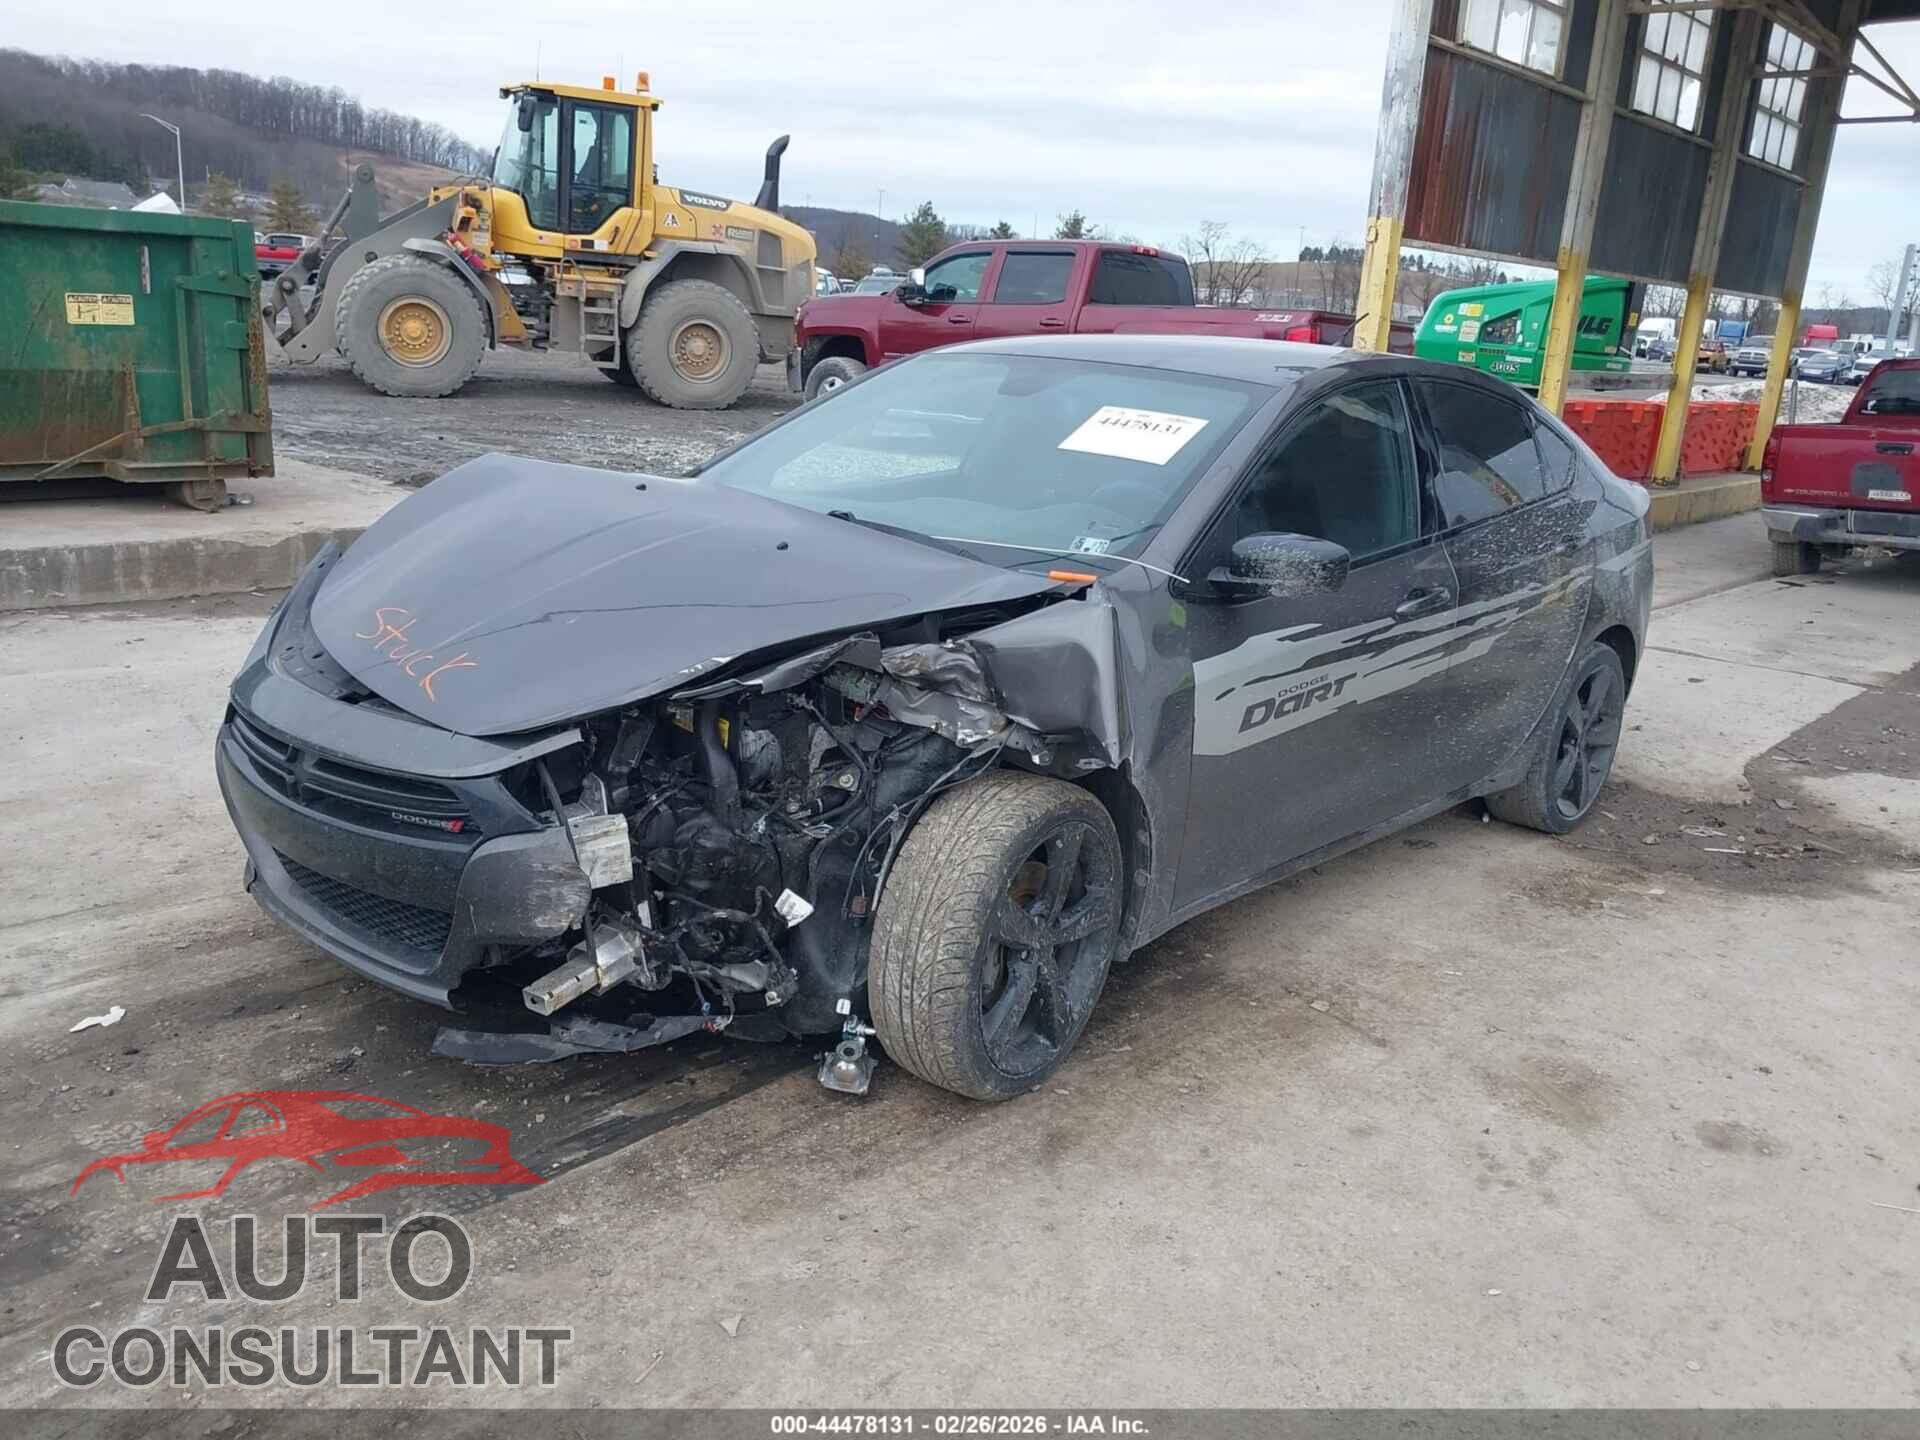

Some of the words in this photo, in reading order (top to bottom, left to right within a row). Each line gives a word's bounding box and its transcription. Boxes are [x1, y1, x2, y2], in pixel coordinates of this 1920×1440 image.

[683, 193, 728, 209] VOLVO
[1098, 415, 1183, 435] 44478131
[1278, 673, 1329, 698] DODGE
[391, 811, 449, 832] DODGE
